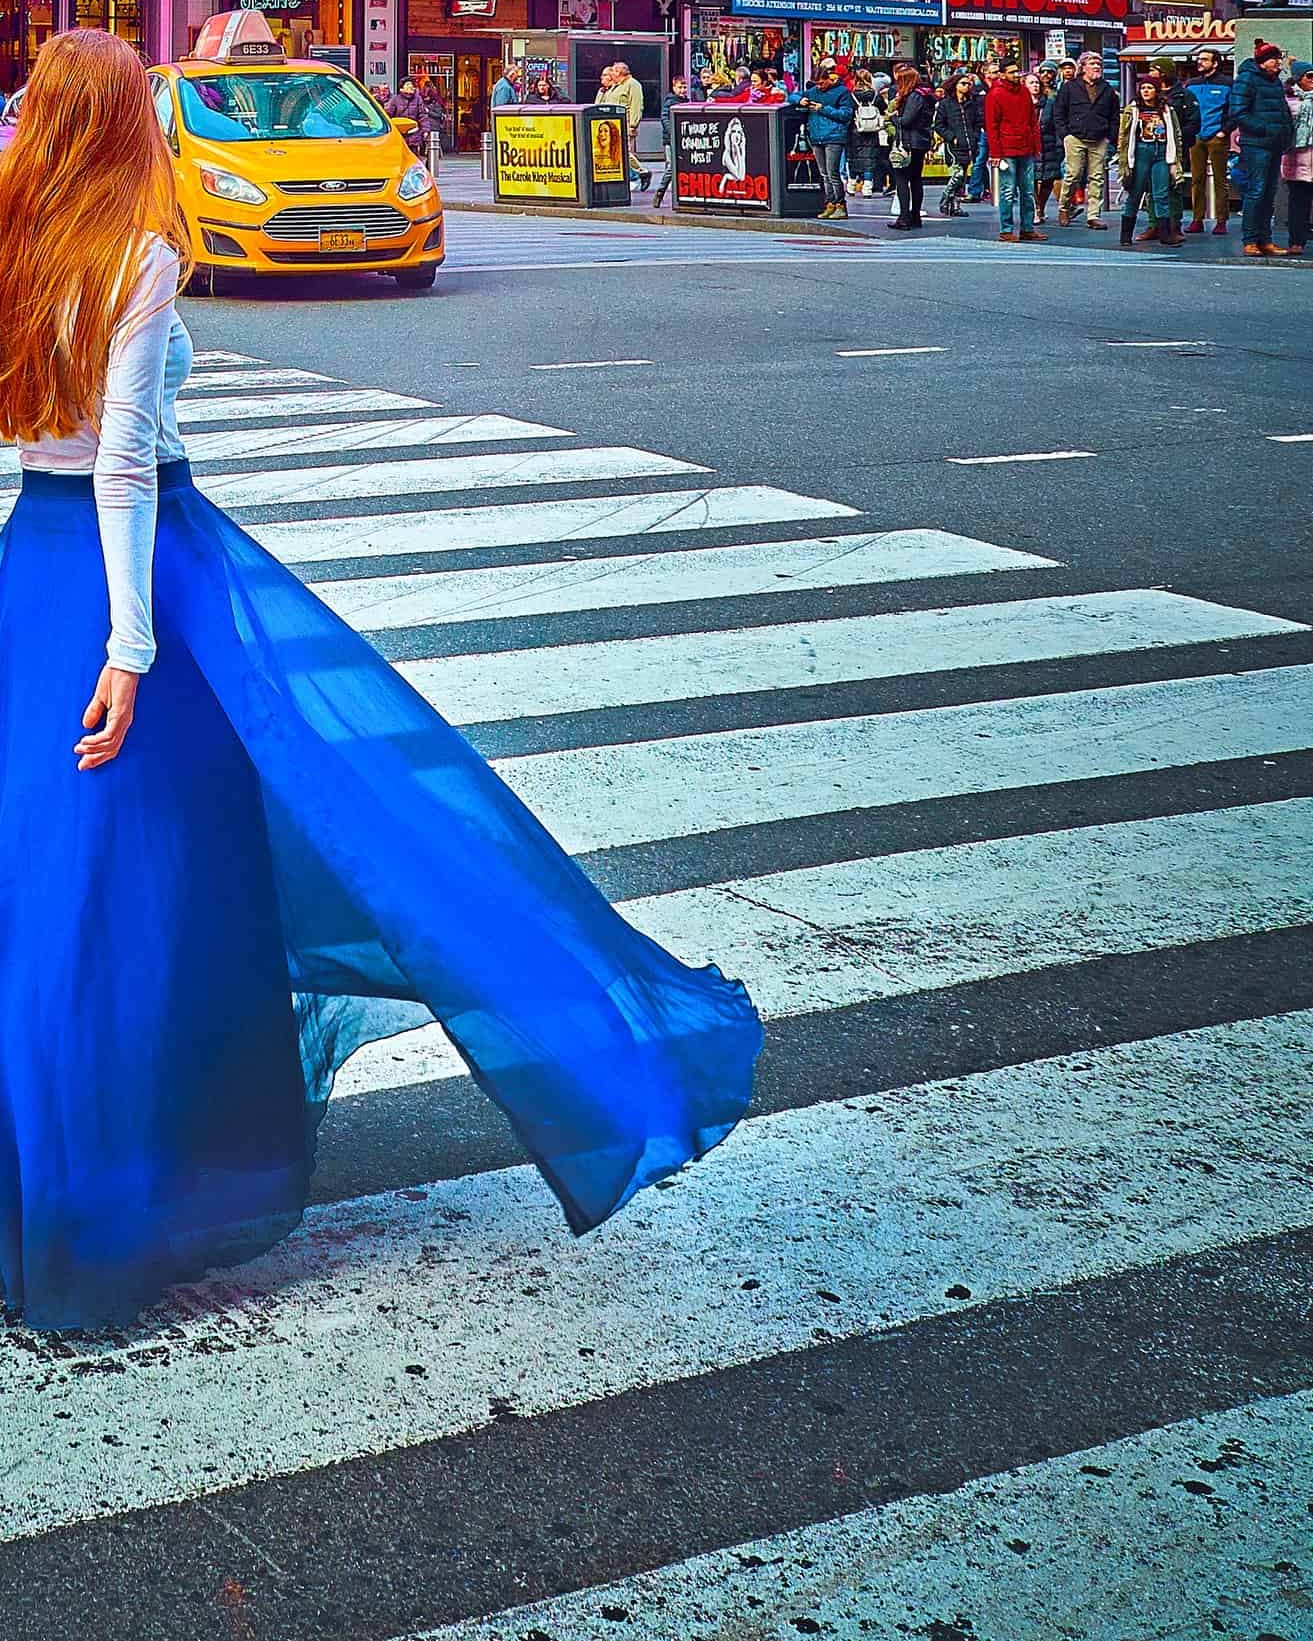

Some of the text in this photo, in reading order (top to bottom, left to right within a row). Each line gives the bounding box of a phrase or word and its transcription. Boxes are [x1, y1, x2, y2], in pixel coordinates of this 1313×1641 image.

[242, 44, 269, 55] 6E33
[824, 30, 987, 62] GRAND SLAM
[527, 63, 548, 71] OPEN
[500, 140, 571, 168] Beautiful
[501, 170, 572, 185] The Carole King Musical
